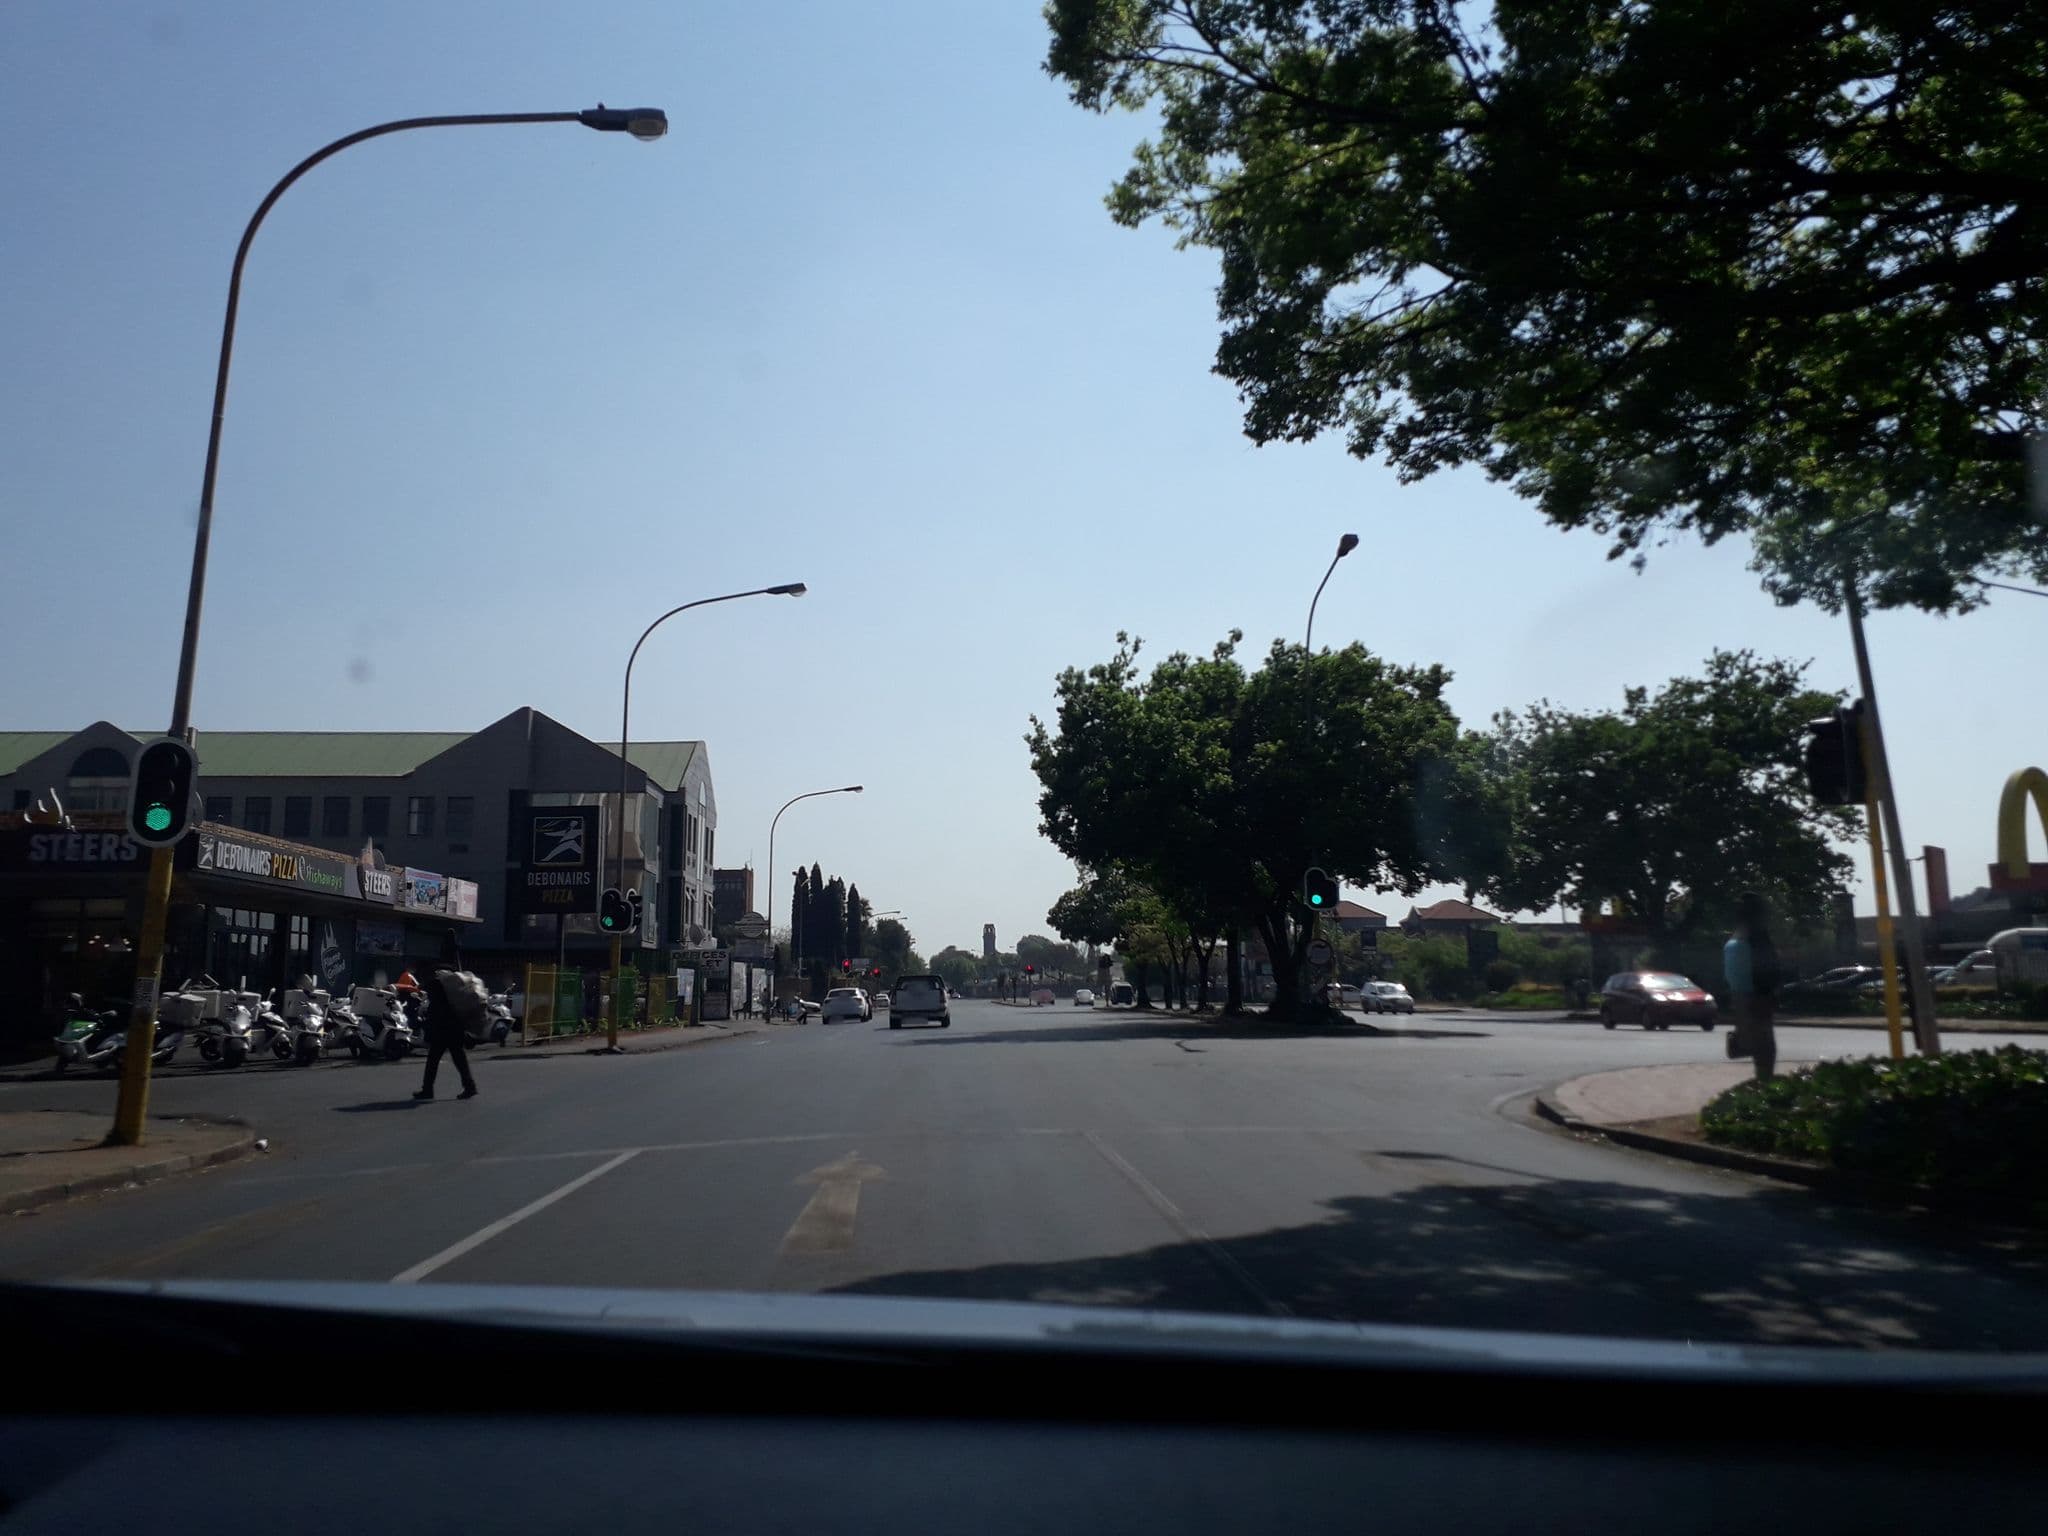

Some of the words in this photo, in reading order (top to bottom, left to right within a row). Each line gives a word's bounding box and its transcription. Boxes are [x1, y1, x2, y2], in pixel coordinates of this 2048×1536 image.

[30, 833, 137, 863] STEERS
[215, 841, 272, 877] DEBONAIRS
[272, 853, 299, 880] PIZZA
[364, 870, 392, 896] STEERS
[527, 870, 591, 886] DEBONAIRS
[542, 888, 575, 903] PIZZA
